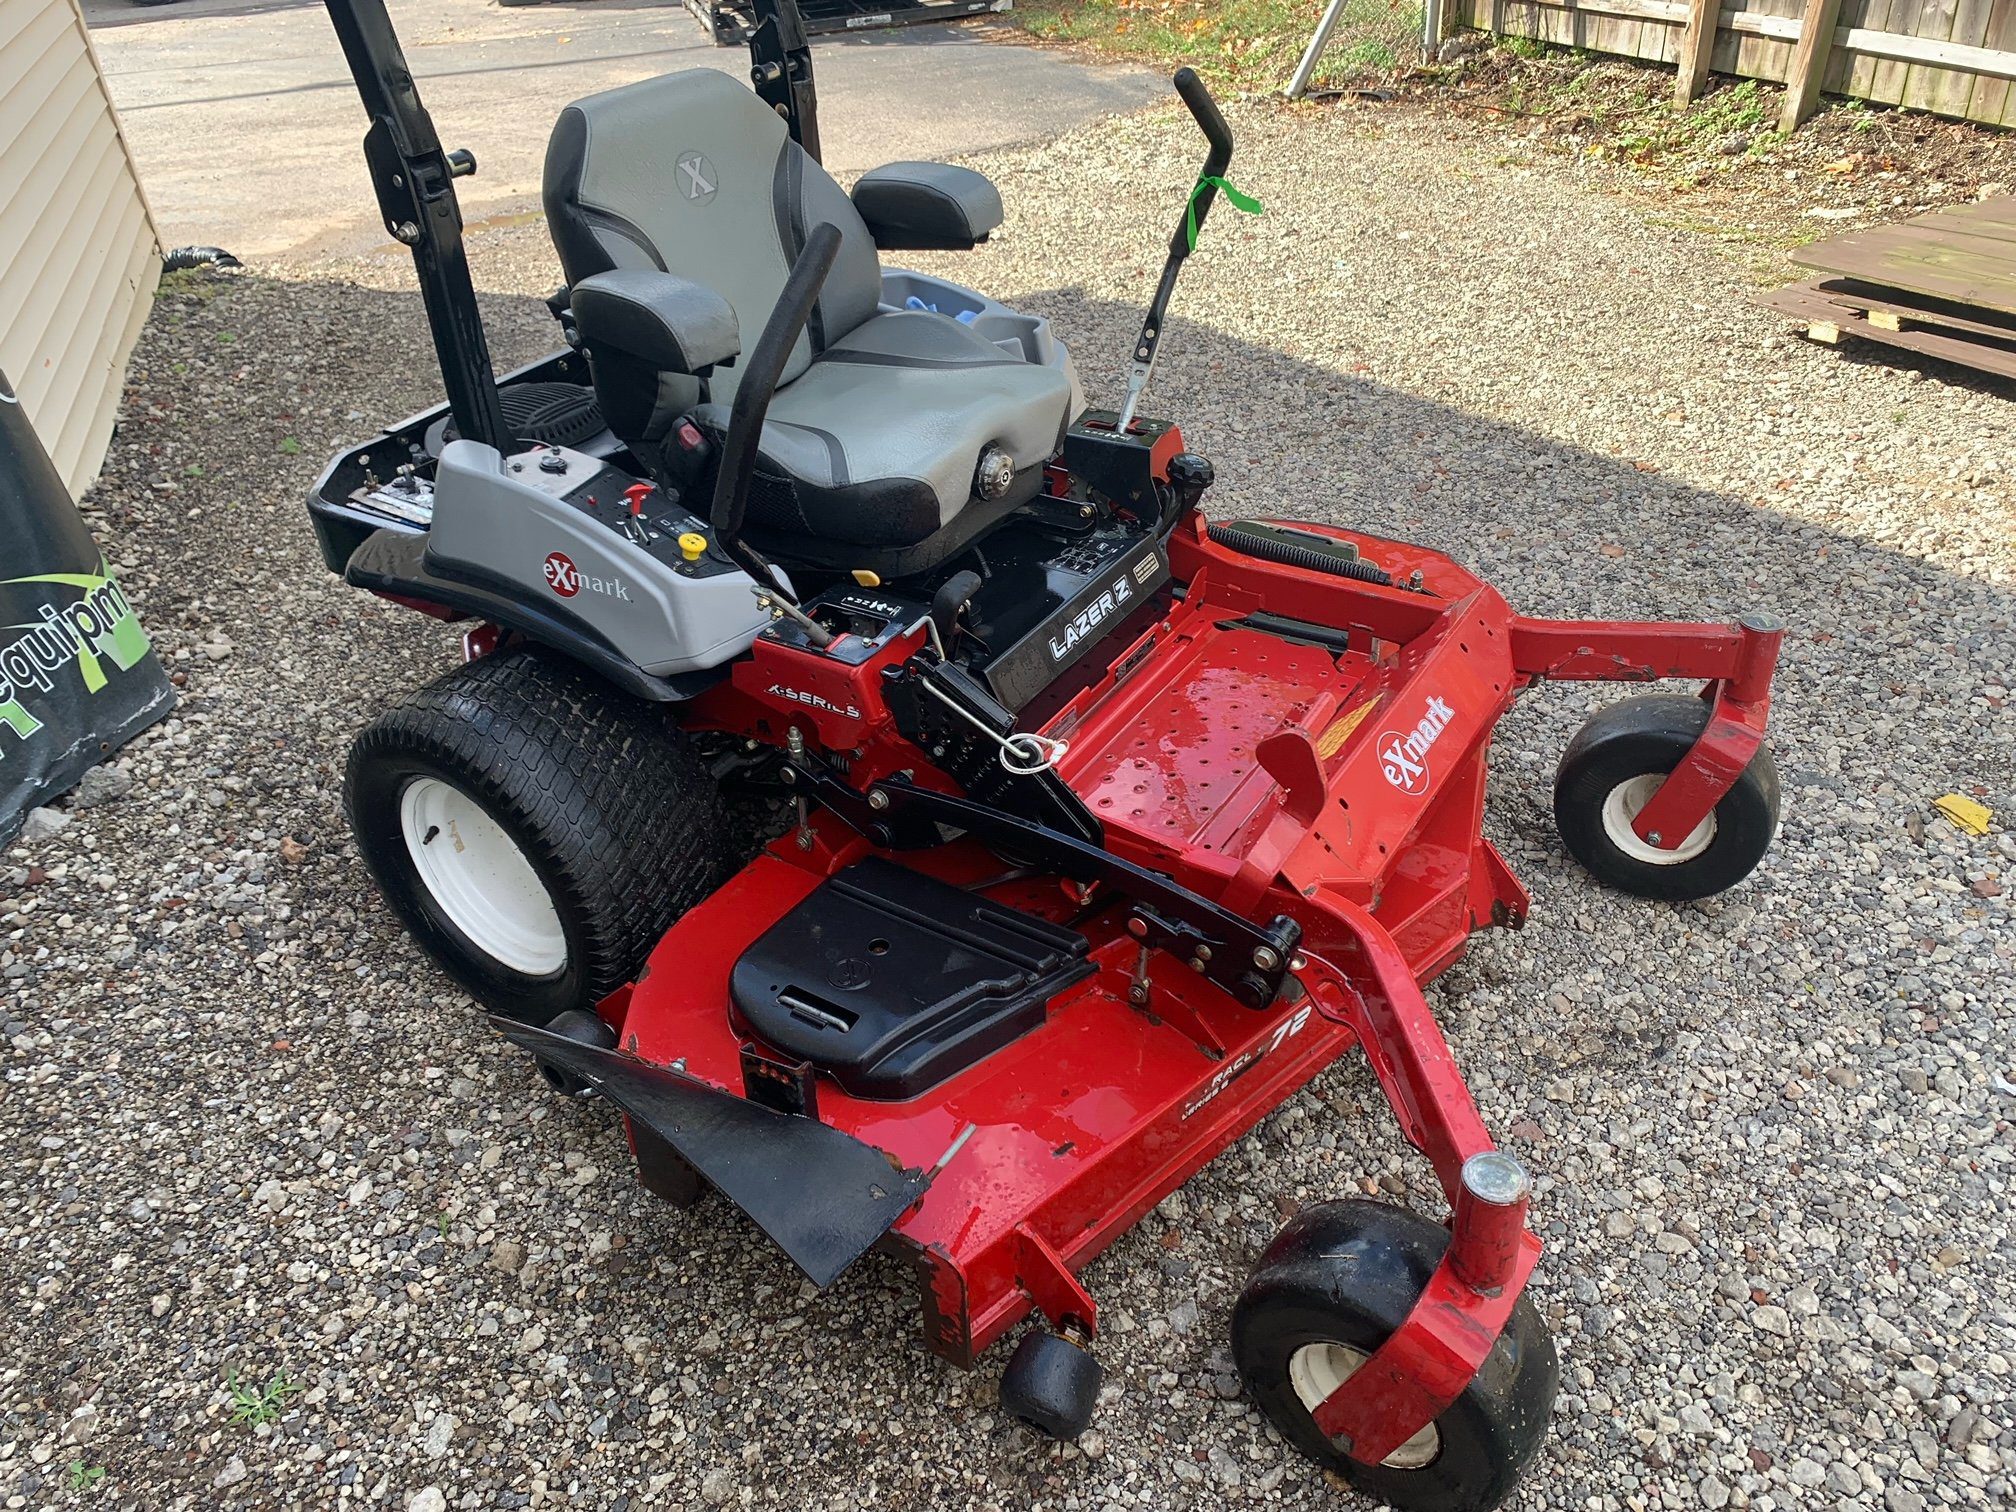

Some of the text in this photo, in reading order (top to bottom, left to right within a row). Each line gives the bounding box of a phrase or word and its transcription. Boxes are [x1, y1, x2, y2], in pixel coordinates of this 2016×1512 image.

[678, 156, 716, 199] X
[542, 558, 630, 602] eXmark
[1049, 590, 1118, 661] LAZER
[1113, 574, 1133, 606] Z
[1382, 695, 1456, 790] eXmark
[1269, 1005, 1312, 1053] 72
